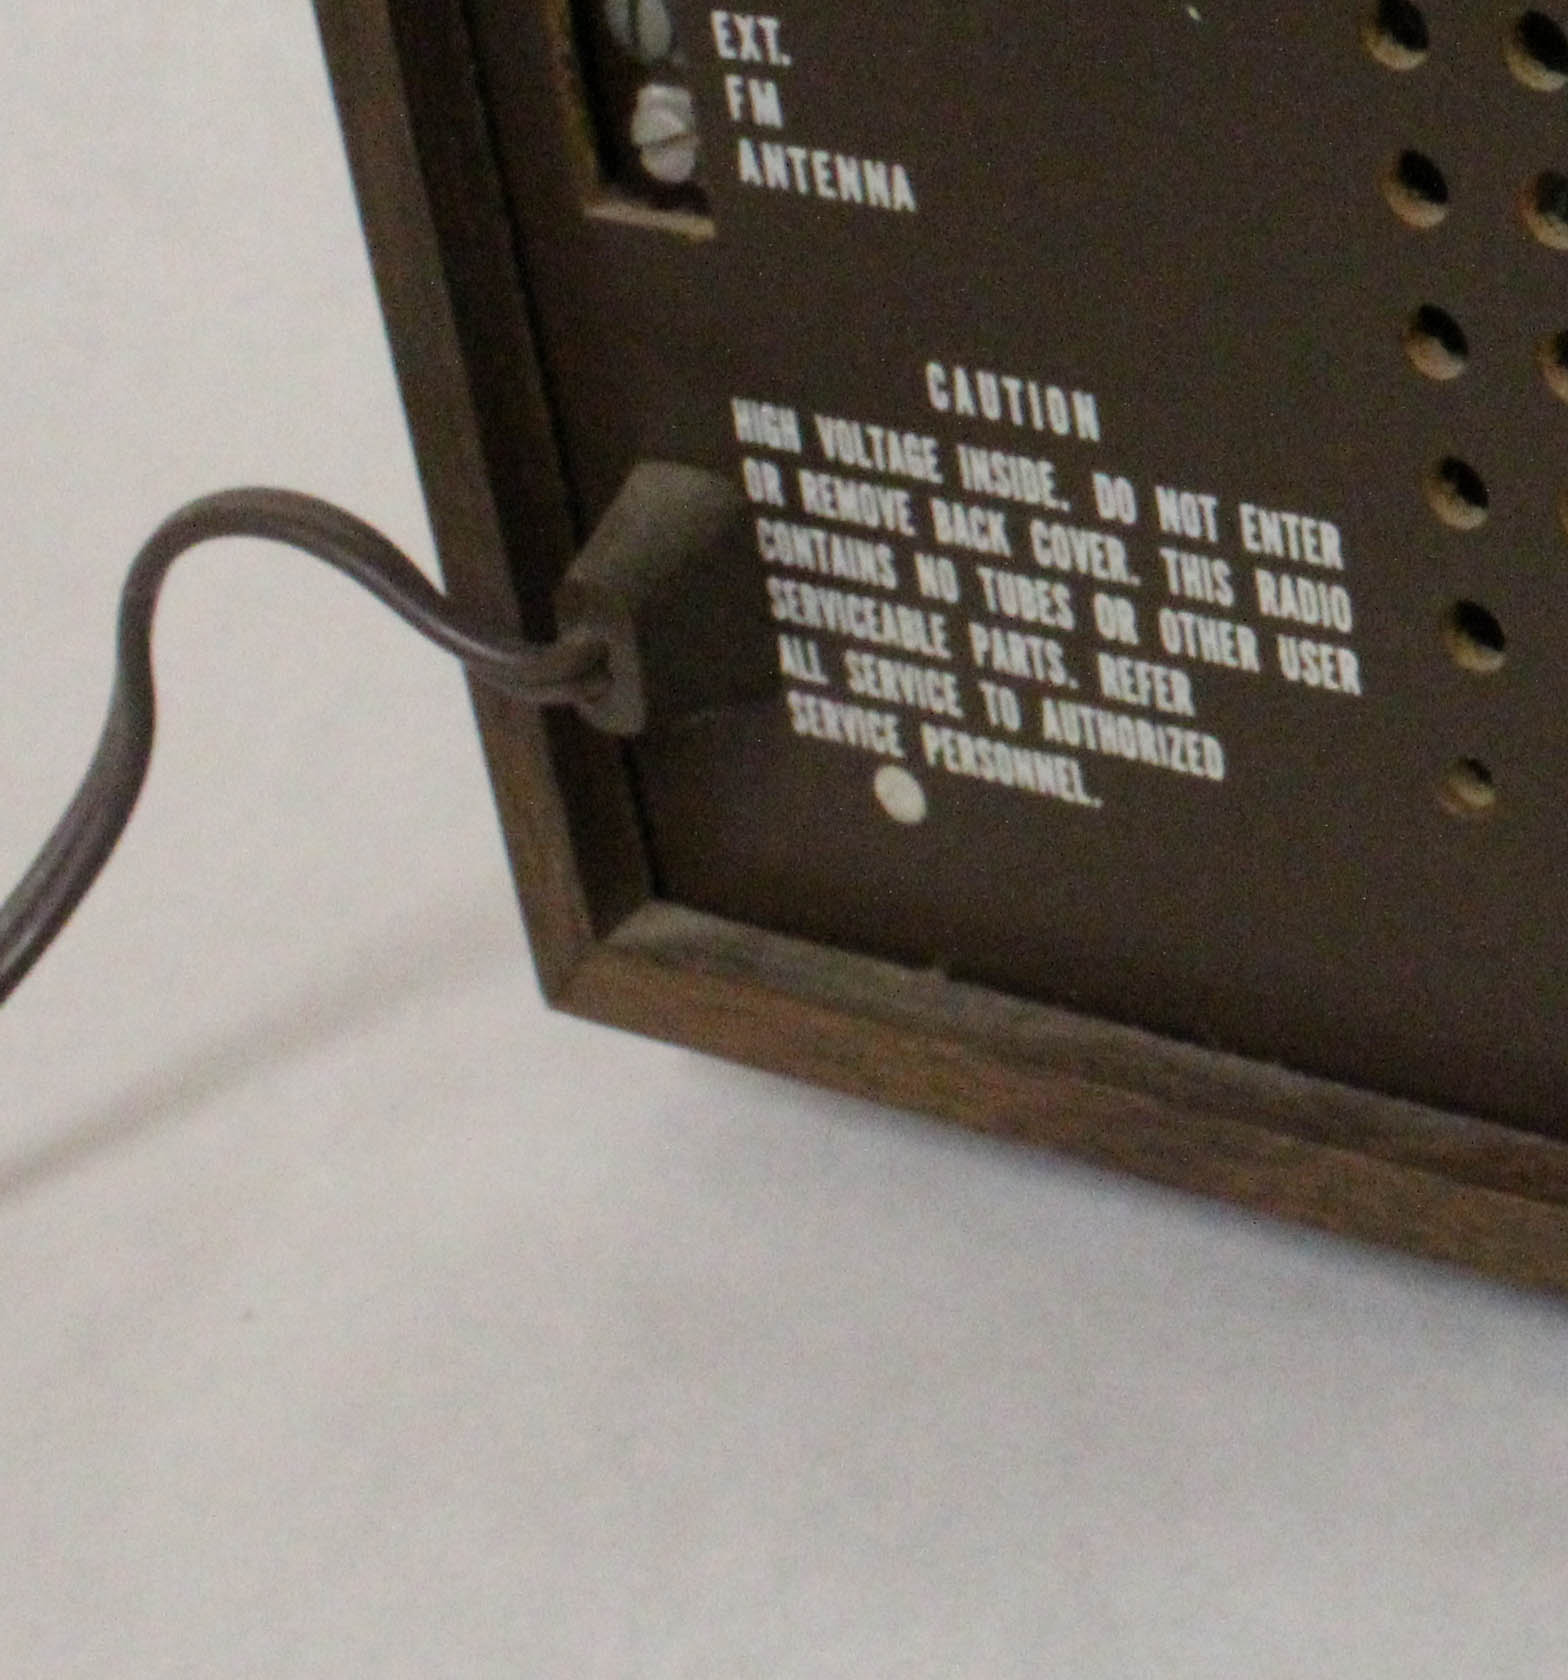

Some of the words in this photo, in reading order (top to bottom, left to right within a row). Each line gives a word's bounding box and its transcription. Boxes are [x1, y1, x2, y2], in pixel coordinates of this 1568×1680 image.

[711, 10, 791, 66] EXT.
[725, 74, 783, 129] FM
[739, 137, 917, 213] ANTENNA
[926, 361, 1100, 442] CAUTION
[731, 397, 801, 453] HIGH
[814, 414, 943, 484] VOLTAGE
[956, 443, 1070, 511] INSIDE.
[1093, 472, 1136, 524] DO
[1155, 485, 1218, 543] NOT
[1239, 502, 1343, 571] ENTER
[743, 457, 783, 508] OR
[798, 467, 917, 537] REMOVE
[930, 496, 1011, 557] BACK
[1029, 520, 1140, 585] COVER.
[1159, 547, 1234, 607] THIS
[1254, 567, 1352, 634] RADIO
[756, 518, 897, 590] CONTAINS
[914, 551, 959, 604] NO
[977, 565, 1075, 631] TUBES
[1094, 592, 1138, 646] OR
[1158, 607, 1260, 673] OTHER
[1277, 633, 1361, 696] USER
[766, 576, 952, 660] SERVICEABLE
[969, 620, 1078, 689] PARTS.
[1097, 651, 1196, 717] REFER
[779, 634, 828, 684] ALL
[844, 649, 964, 719] SERVICE
[978, 679, 1020, 732] TO
[1042, 697, 1224, 782] AUTHORIZED
[787, 690, 906, 759] SERVICE
